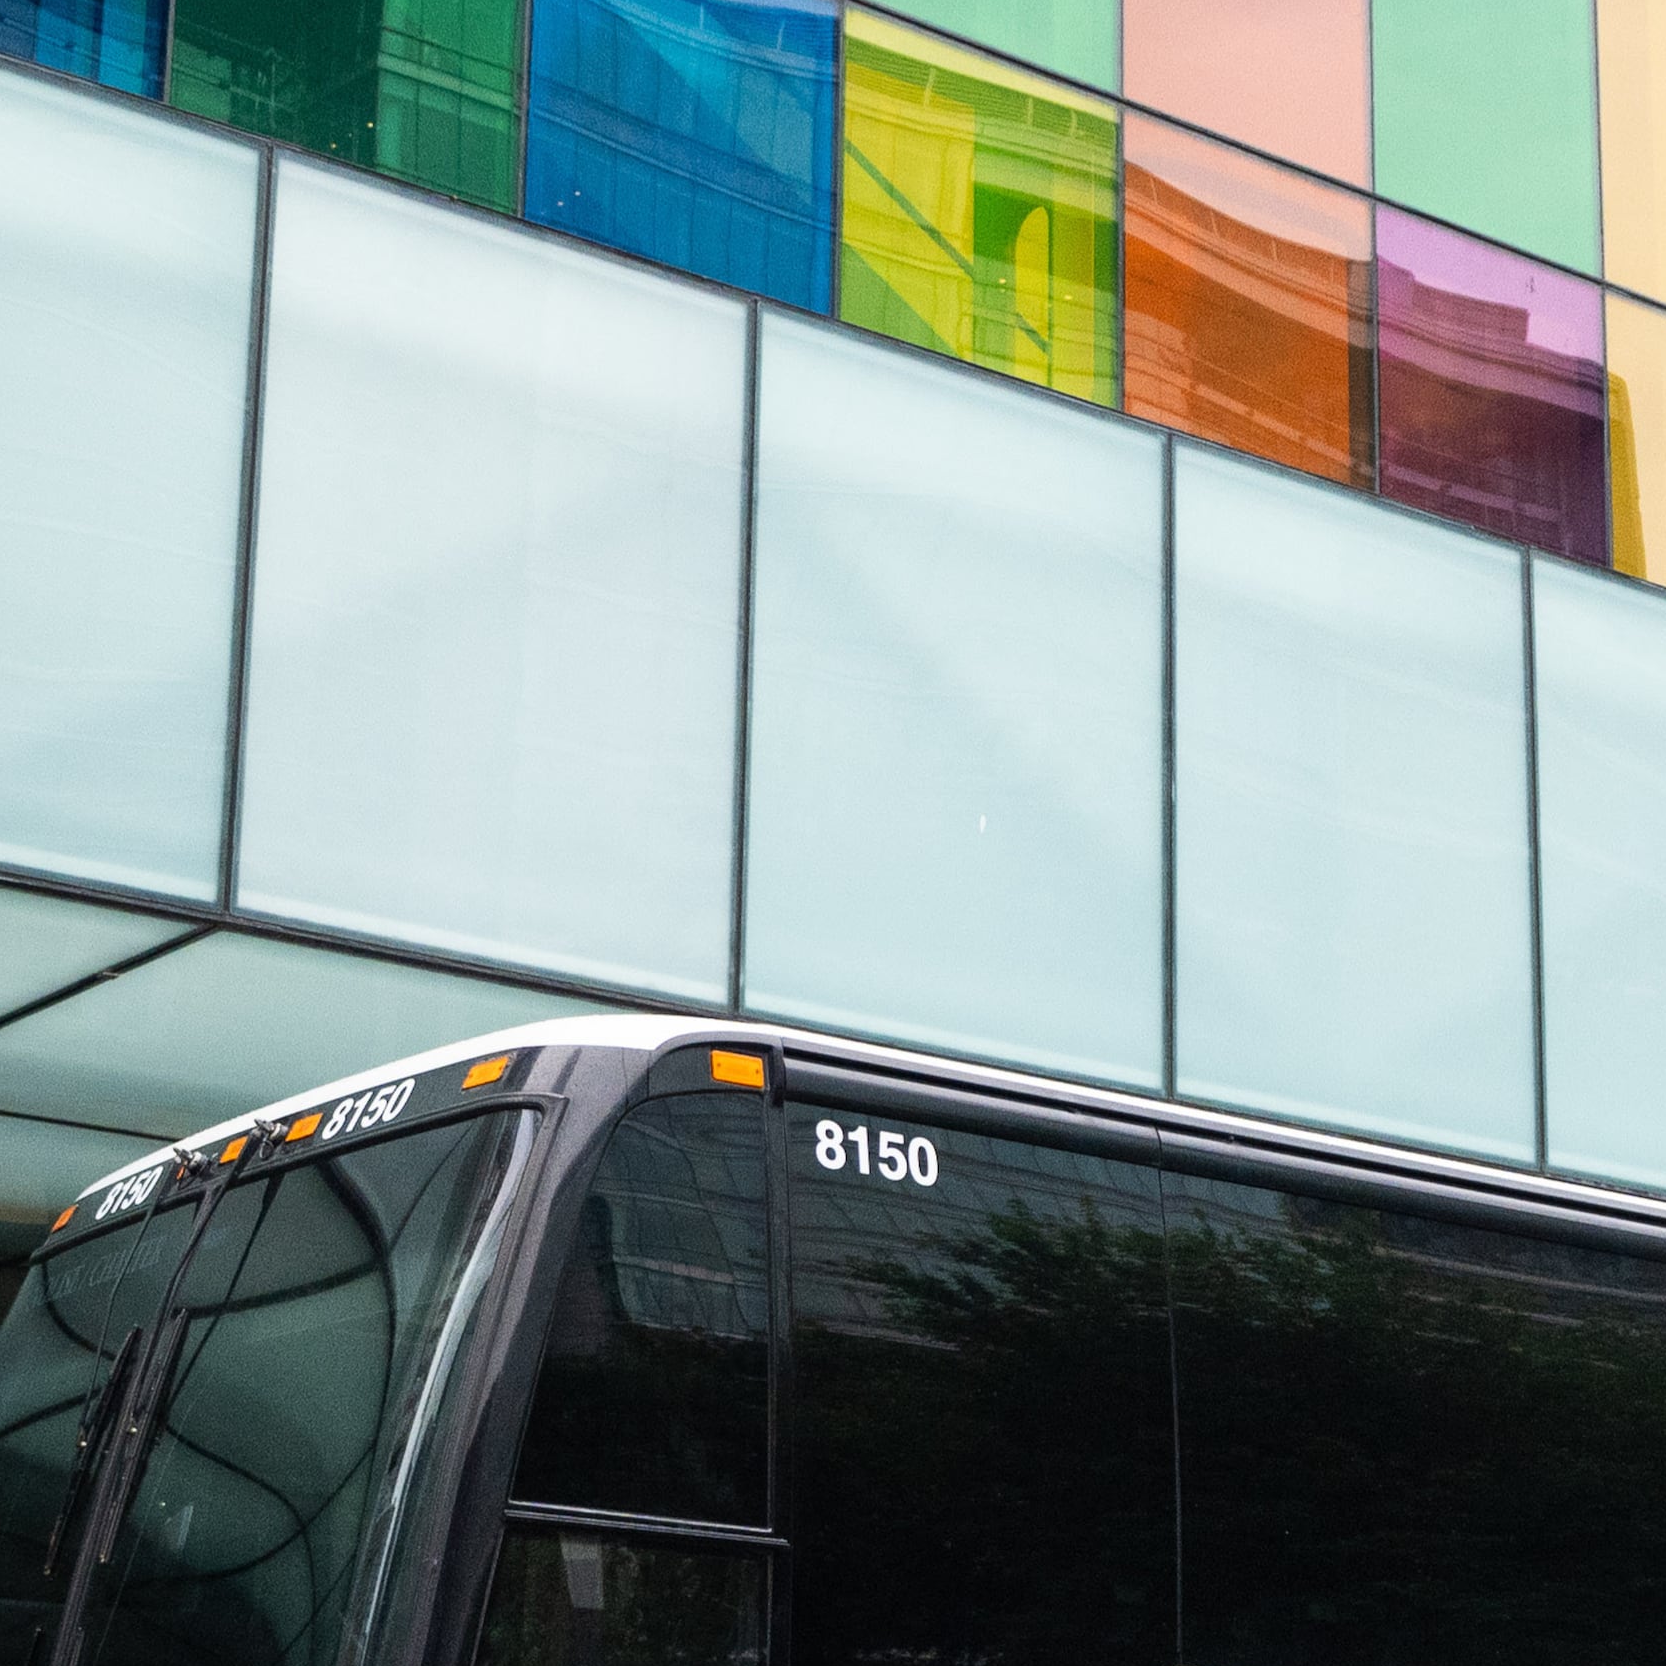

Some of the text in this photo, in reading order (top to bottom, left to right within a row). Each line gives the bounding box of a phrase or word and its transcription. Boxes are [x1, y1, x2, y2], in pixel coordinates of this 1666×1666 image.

[320, 1076, 415, 1141] 8150
[815, 1119, 939, 1187] 8150
[94, 1165, 164, 1221] 8150
